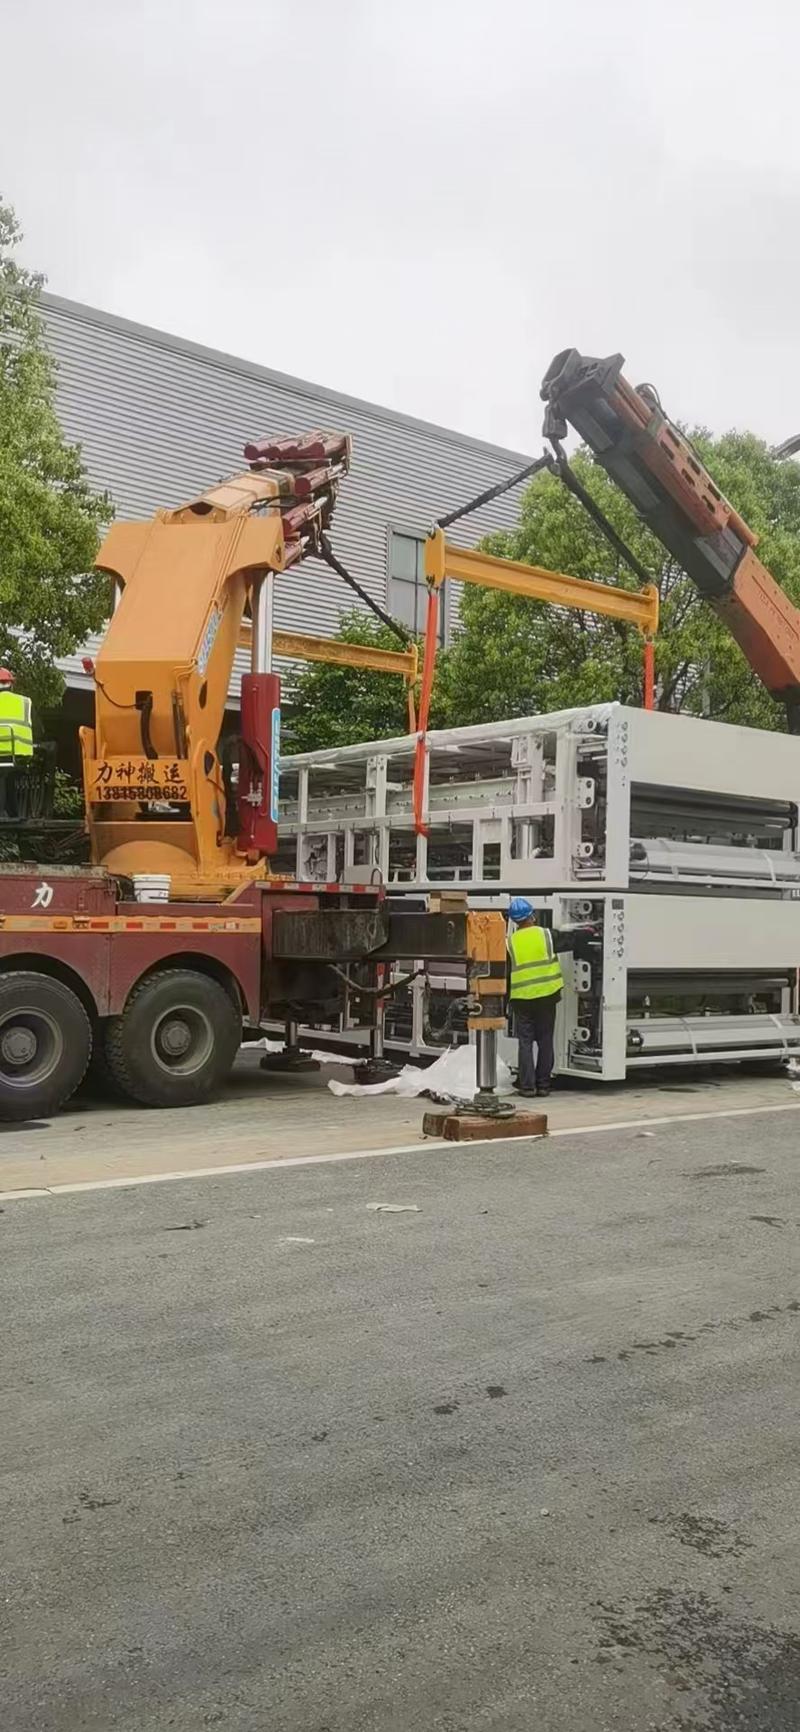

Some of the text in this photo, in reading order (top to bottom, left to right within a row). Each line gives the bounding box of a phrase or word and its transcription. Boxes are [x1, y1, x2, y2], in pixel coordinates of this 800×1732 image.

[95, 761, 184, 784] 力神搬运
[30, 881, 54, 908] 力
